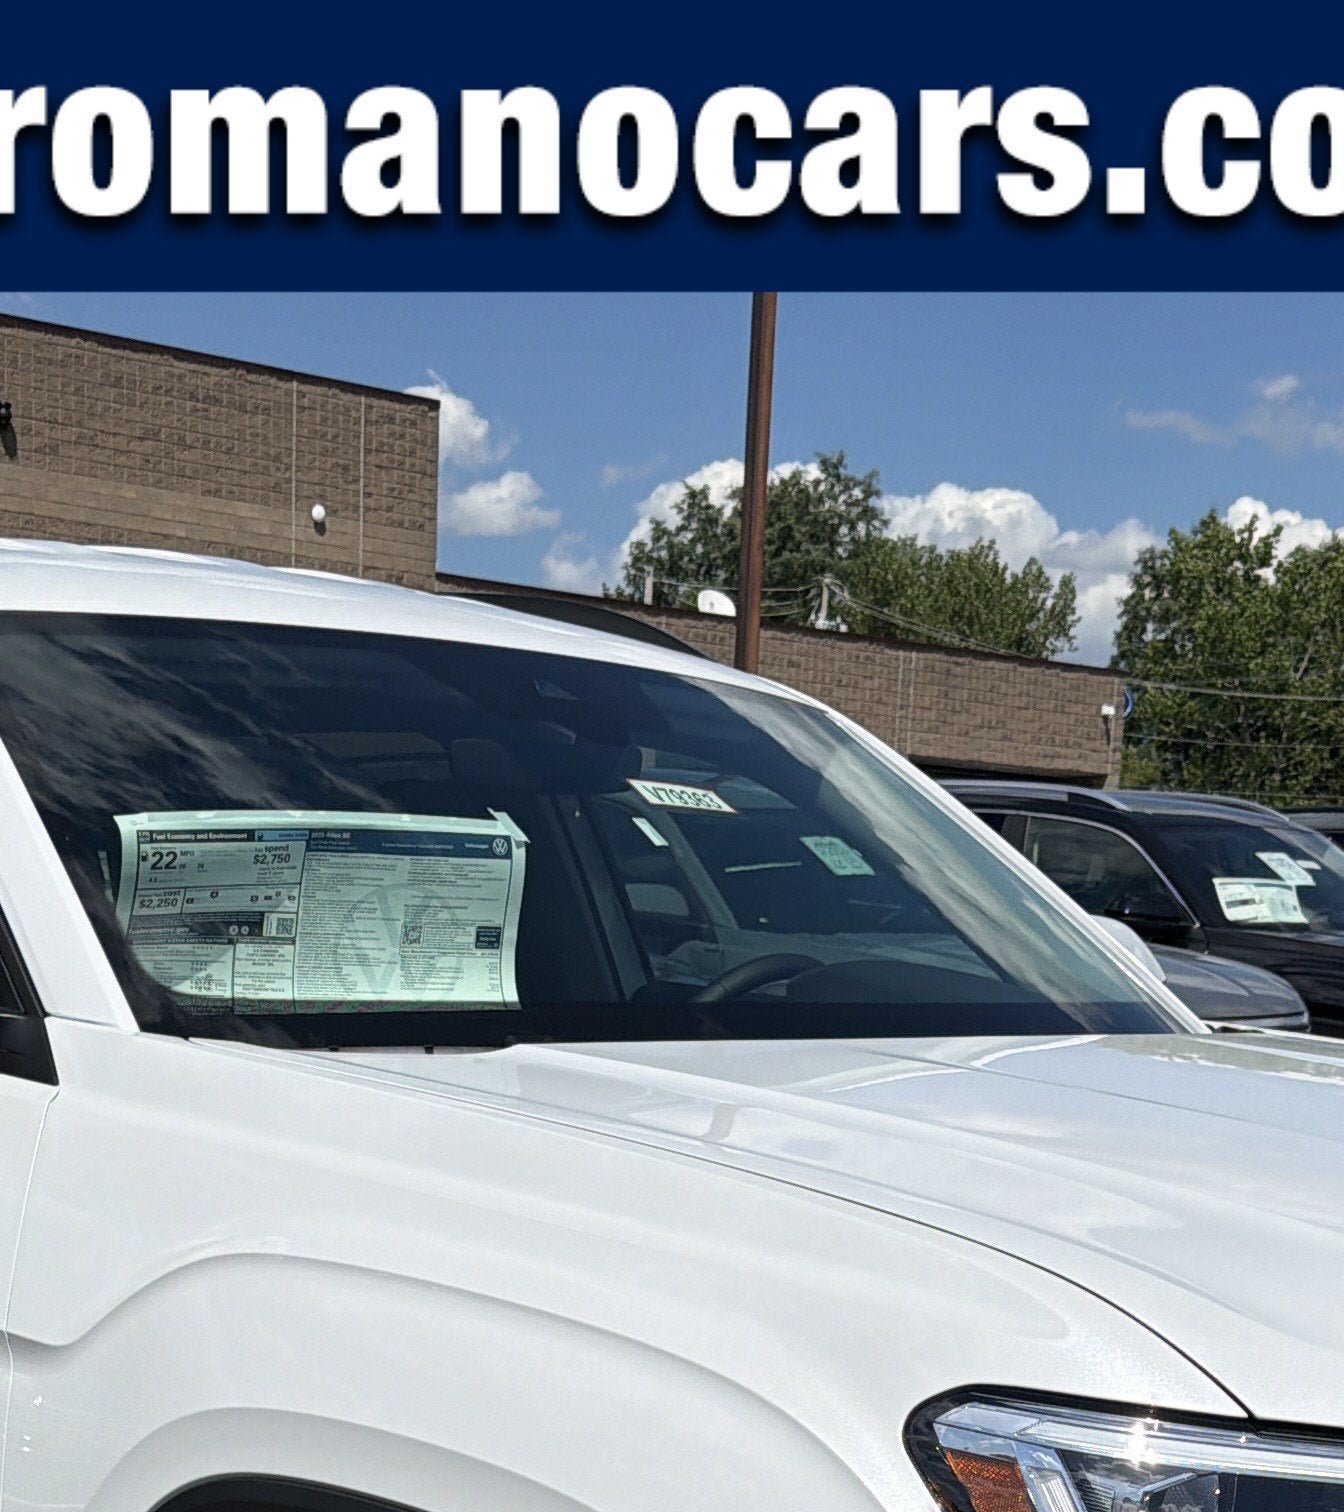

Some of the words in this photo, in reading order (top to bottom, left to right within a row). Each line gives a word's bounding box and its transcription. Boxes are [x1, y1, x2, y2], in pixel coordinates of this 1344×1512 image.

[640, 785, 724, 811] V79363
[264, 844, 290, 854] spend
[150, 851, 178, 870] 22
[253, 853, 291, 866] $2,750
[138, 898, 179, 910] $2,250
